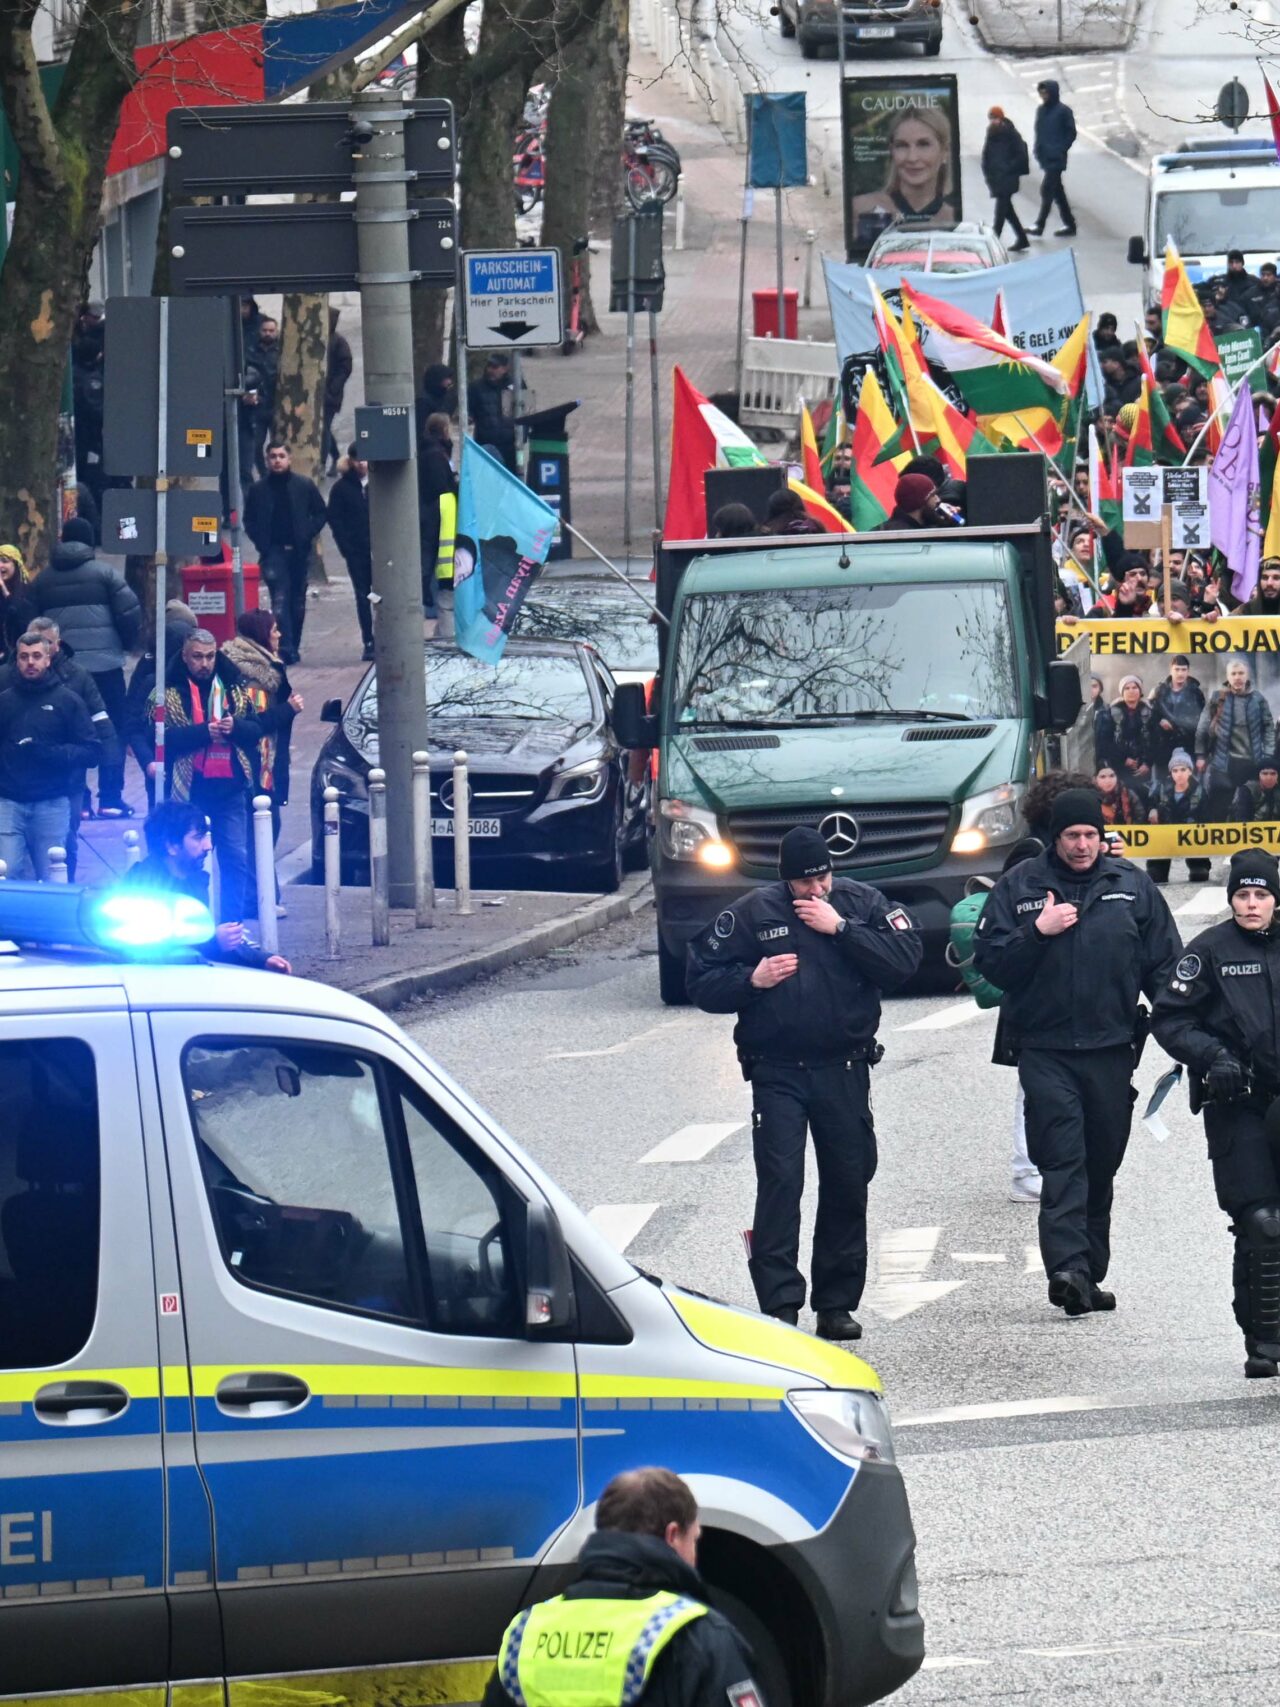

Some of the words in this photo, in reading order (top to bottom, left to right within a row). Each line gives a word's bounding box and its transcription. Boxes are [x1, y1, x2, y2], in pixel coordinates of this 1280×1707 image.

[437, 220, 451, 229] 224
[474, 259, 549, 275] PARKSCHEIN-
[486, 276, 537, 291] AUTOMAT
[470, 298, 492, 307] Hier
[497, 296, 554, 306] Parkschein
[498, 309, 527, 318] lösen
[1239, 877, 1267, 886] POLIZEI
[1221, 963, 1261, 977] POLIZEI
[533, 1631, 614, 1659] POLIZEI
